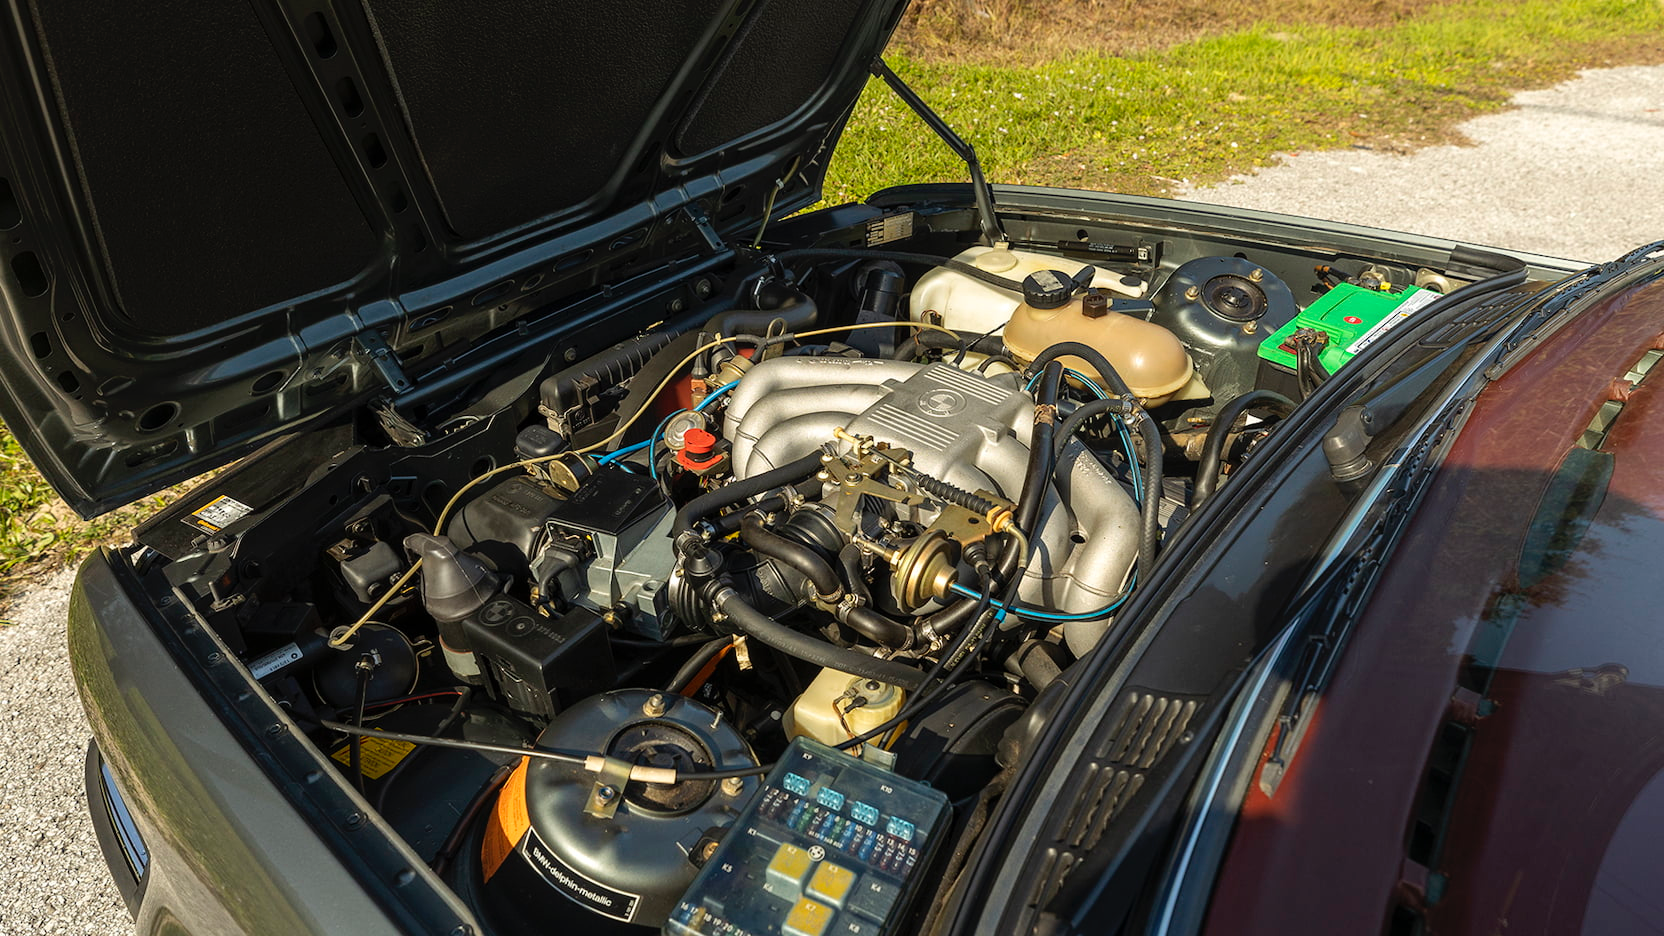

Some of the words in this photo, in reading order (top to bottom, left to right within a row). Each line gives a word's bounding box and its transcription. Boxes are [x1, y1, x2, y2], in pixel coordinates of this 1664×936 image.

[880, 784, 893, 794] K10
[721, 863, 733, 873] K5
[871, 883, 882, 893] K4
[849, 923, 860, 934] K8
